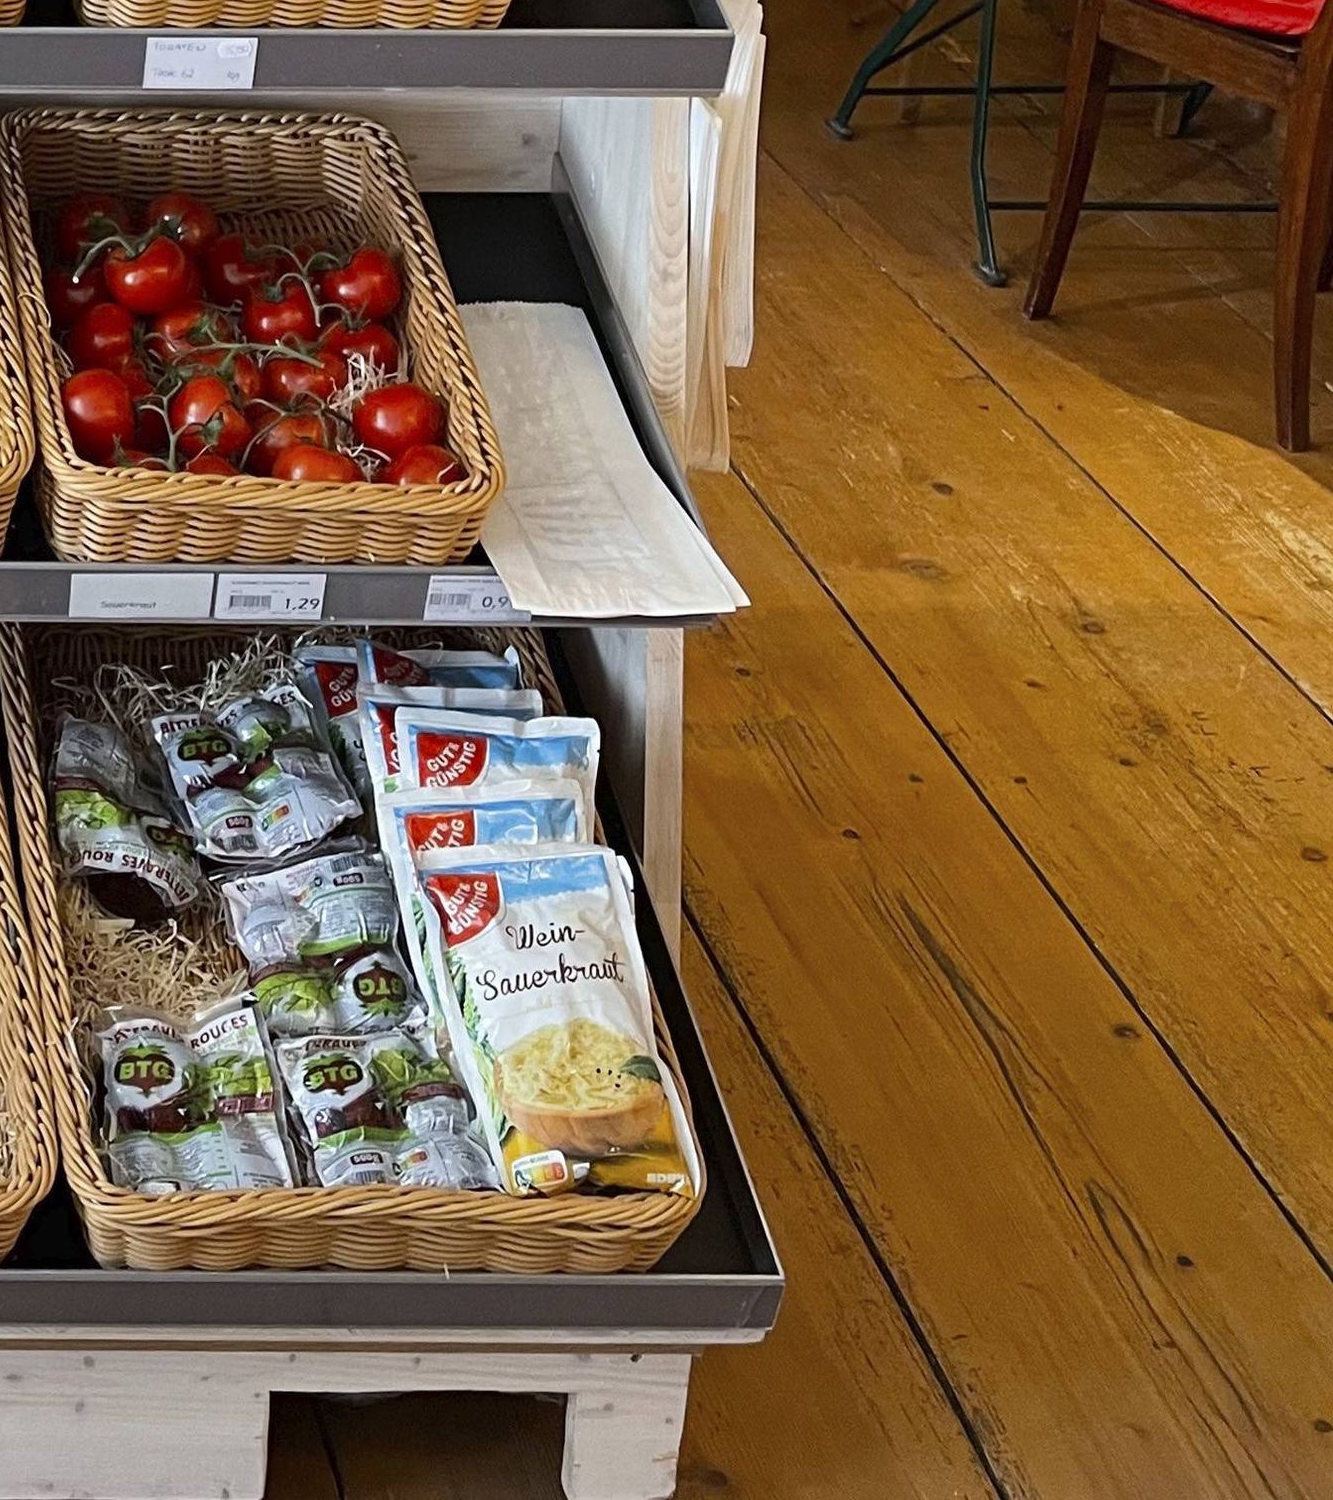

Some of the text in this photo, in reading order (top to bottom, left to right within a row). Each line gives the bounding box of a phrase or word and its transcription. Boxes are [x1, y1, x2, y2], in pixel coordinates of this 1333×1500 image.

[154, 42, 207, 52] TOMATEN
[100, 599, 157, 610] Sauerkraut
[283, 596, 321, 612] 1,29
[481, 594, 511, 610] 0,9
[182, 739, 228, 757] BTG
[425, 740, 478, 788] GÜNSTIG
[450, 880, 489, 935] GÜNSTIG
[505, 921, 586, 951] Wein-
[476, 953, 626, 1002] Sauerkraut
[190, 1013, 249, 1050] ROUGES
[118, 1060, 173, 1081] BTG
[305, 1063, 359, 1086] BTG
